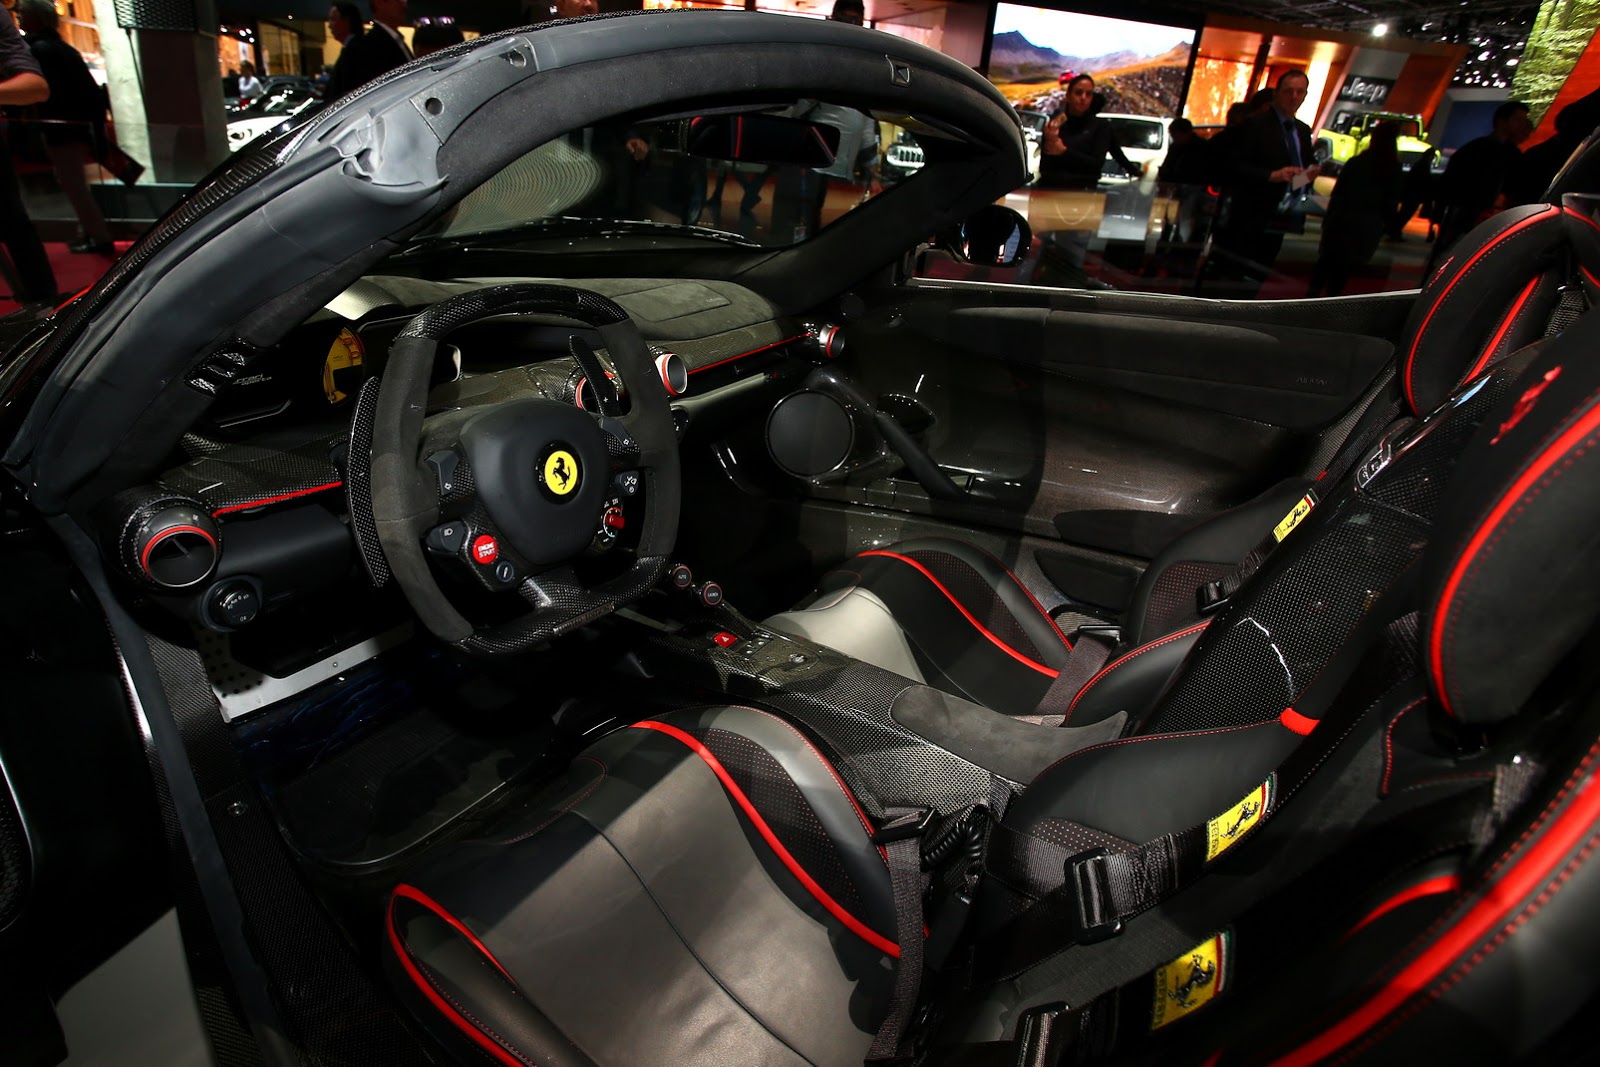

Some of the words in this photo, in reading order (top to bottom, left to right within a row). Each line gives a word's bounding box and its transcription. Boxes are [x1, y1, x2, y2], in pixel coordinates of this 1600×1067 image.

[1342, 77, 1388, 103] Jeep
[478, 541, 495, 552] ENGINE
[479, 548, 496, 559] START
[558, 616, 583, 632] LIMITED
[585, 603, 612, 621] EDITION
